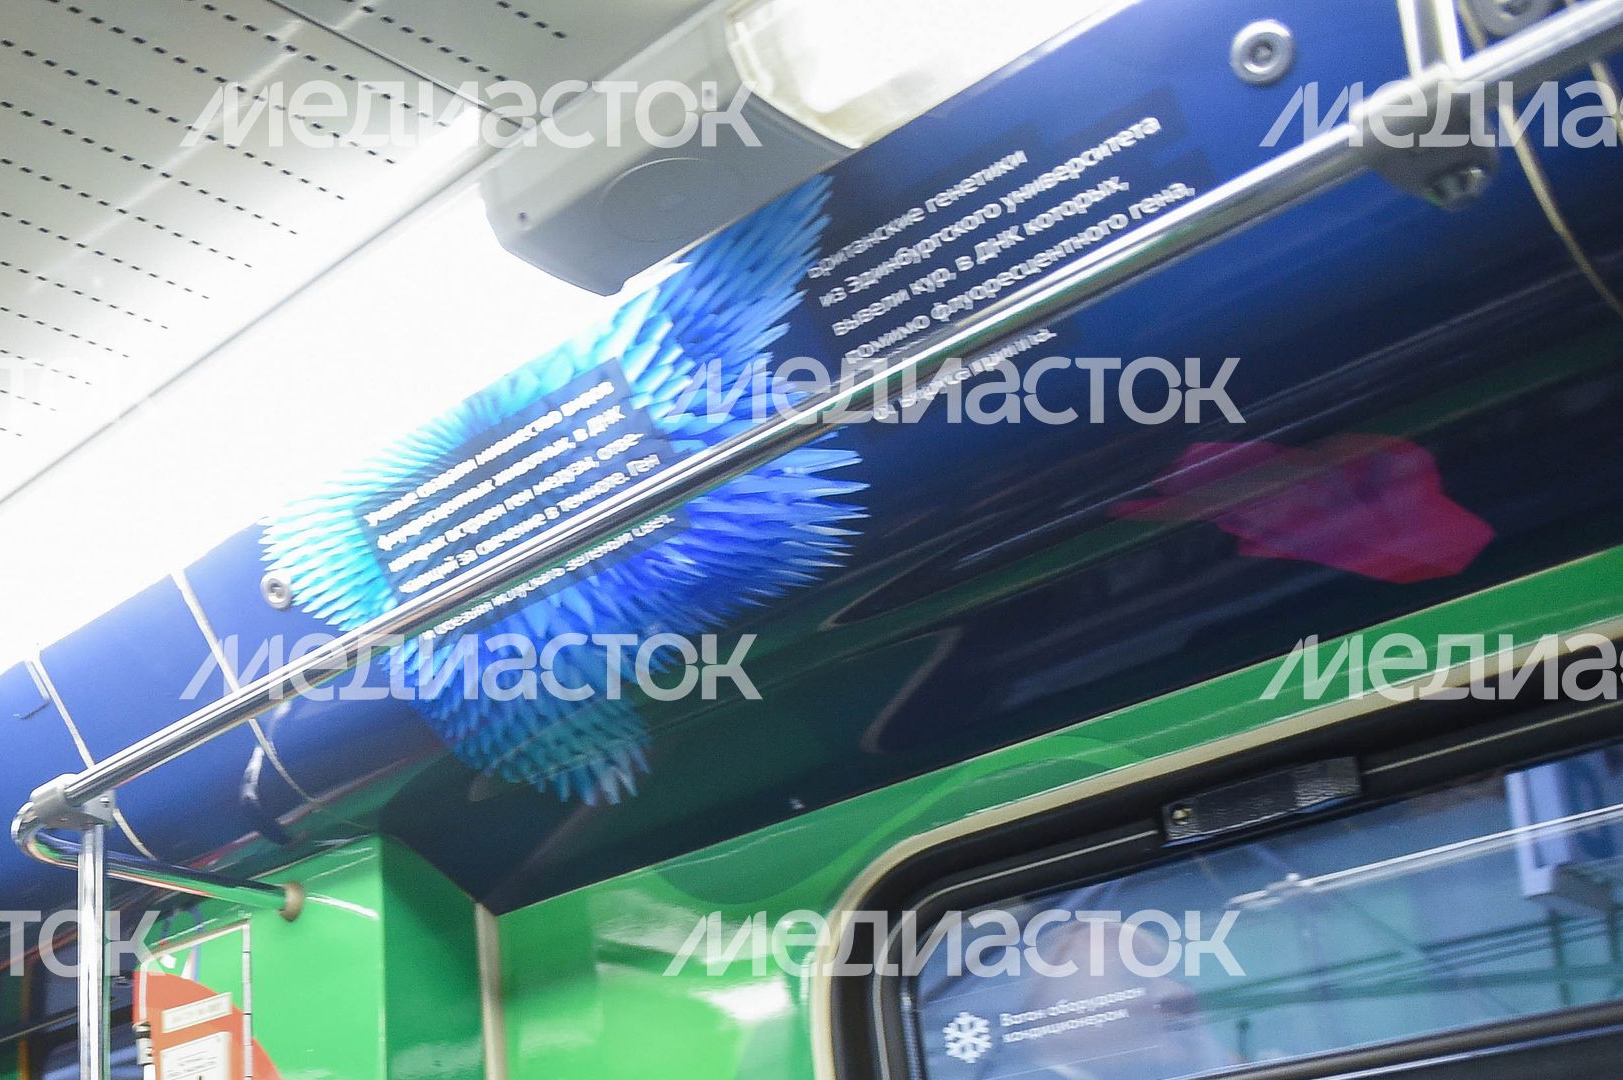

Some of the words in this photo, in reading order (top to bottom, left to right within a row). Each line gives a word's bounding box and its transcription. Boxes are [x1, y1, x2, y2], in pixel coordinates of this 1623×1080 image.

[819, 286, 847, 307] из
[844, 203, 1002, 293] Эдинбургского
[999, 116, 1162, 213] университета
[925, 150, 1027, 212] генетики
[832, 289, 911, 336] вывели
[955, 255, 974, 271] в
[974, 225, 1025, 265] ДНК
